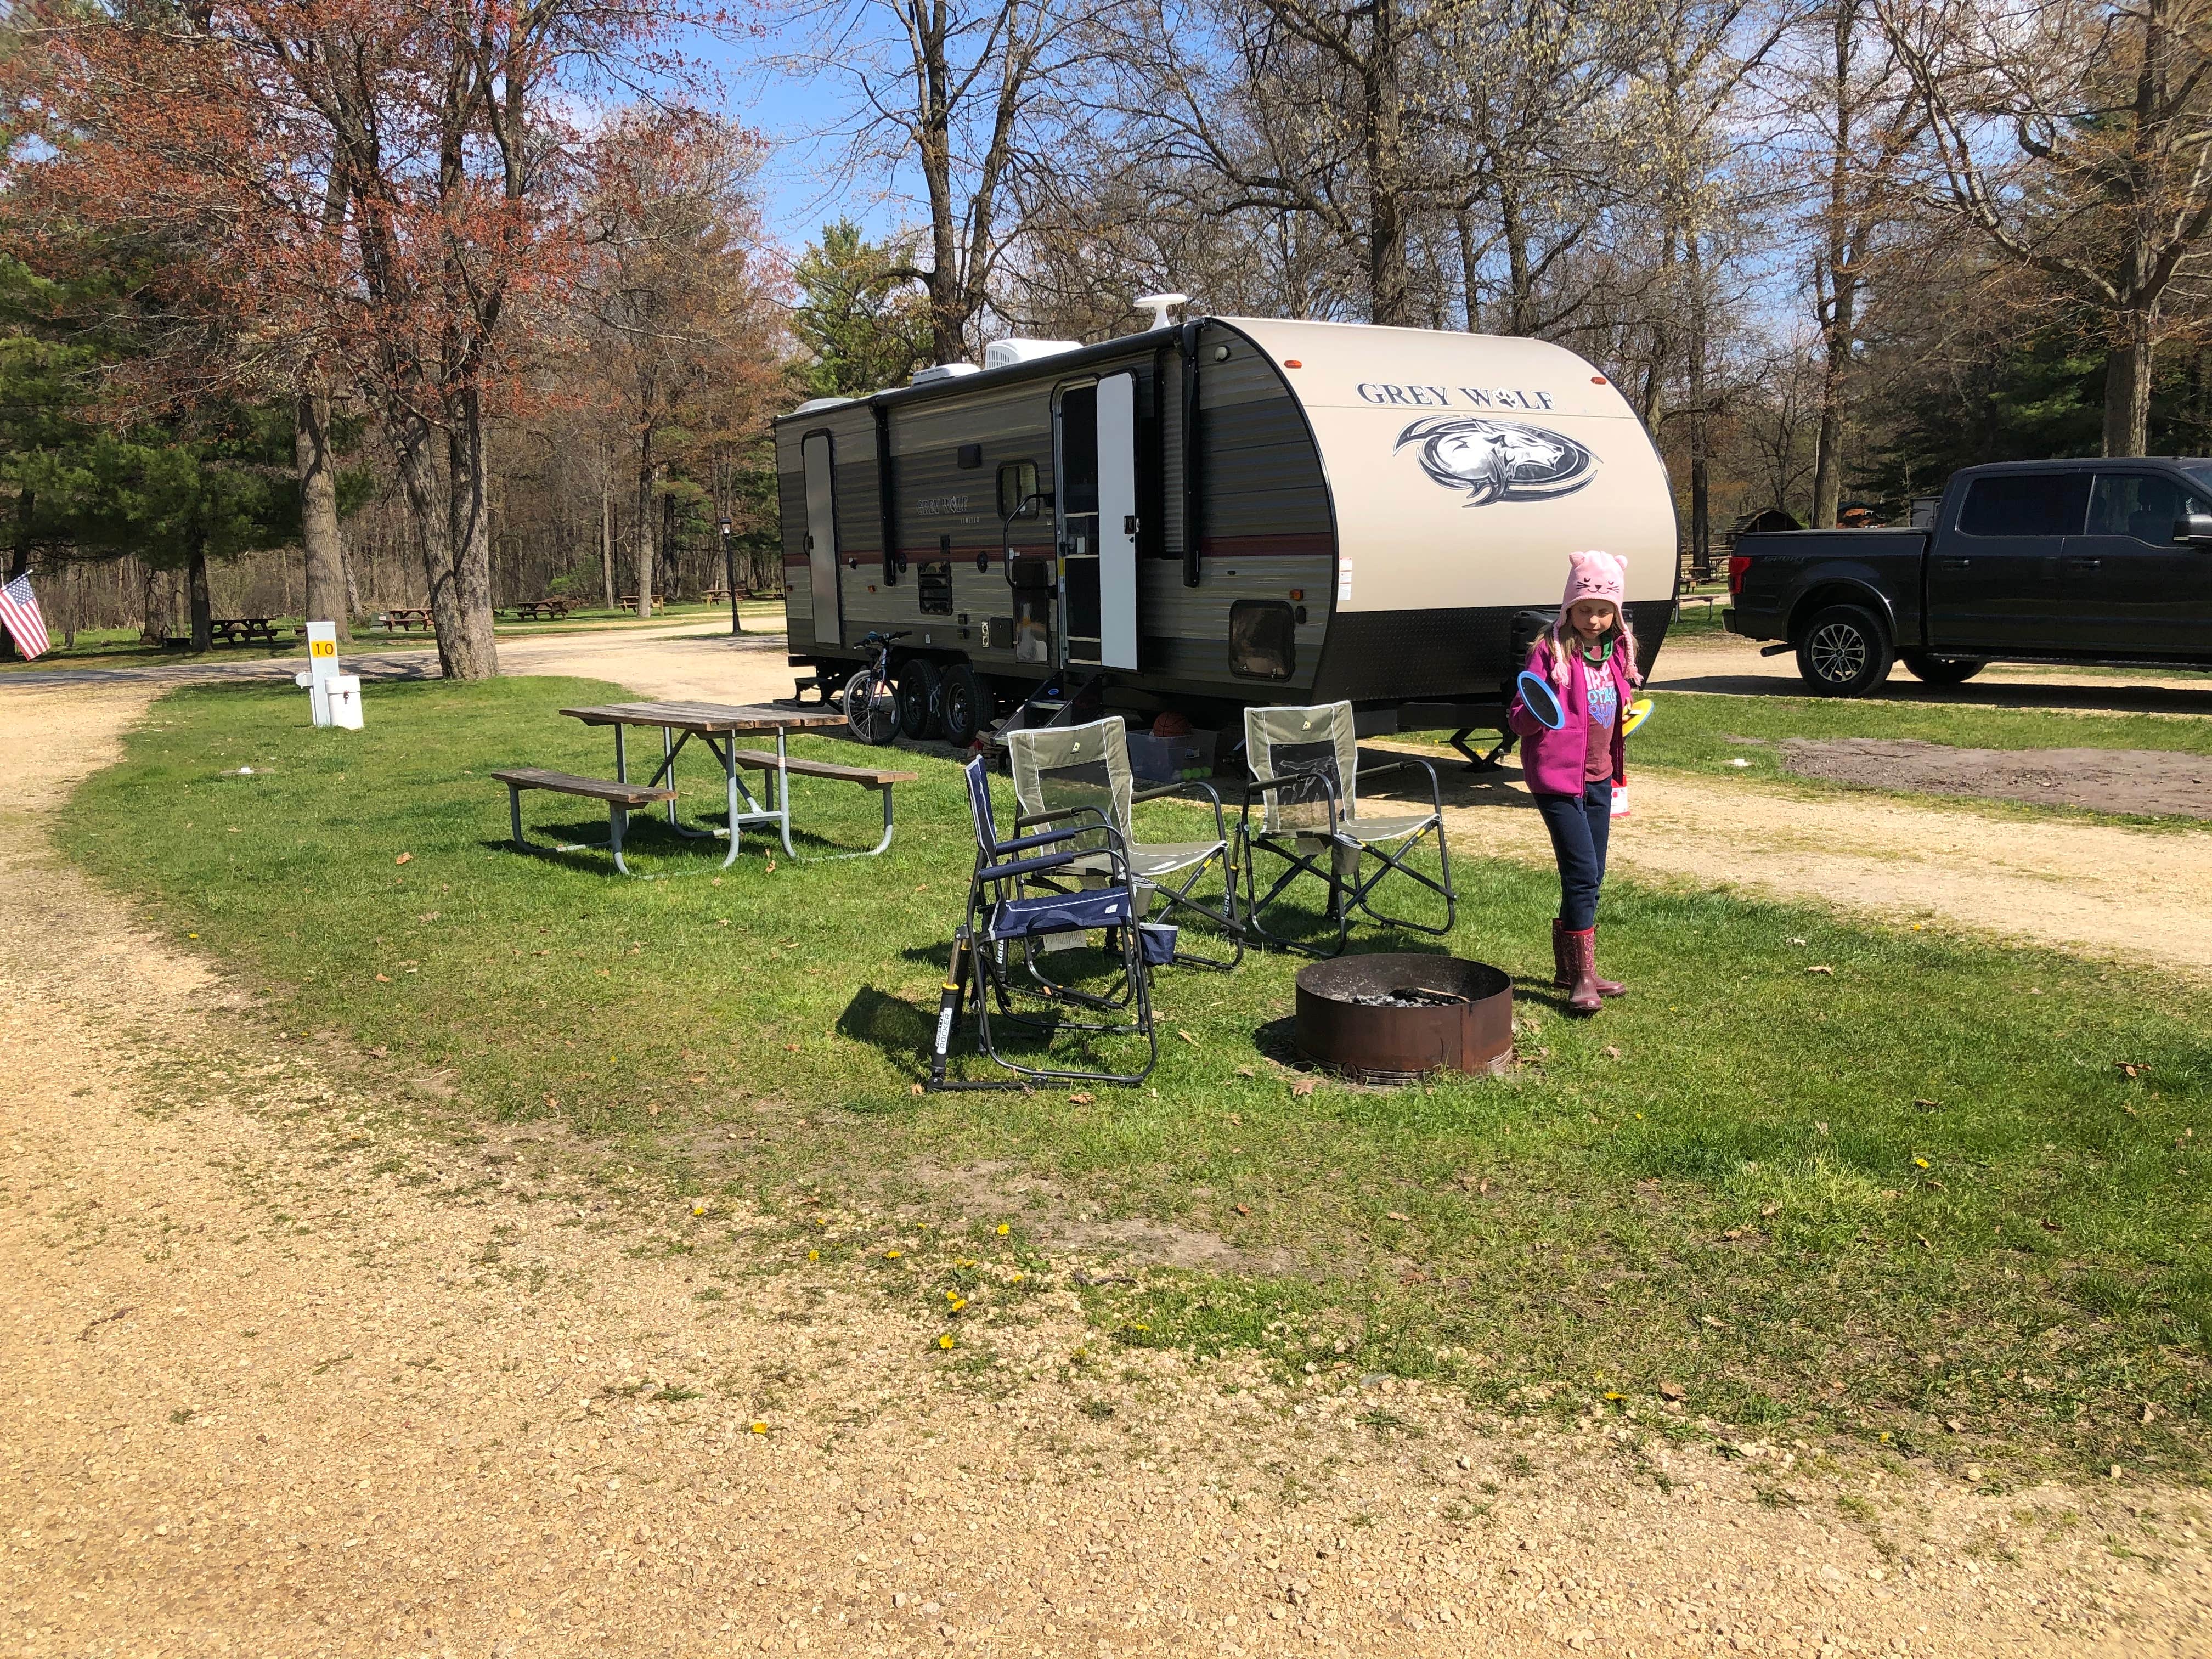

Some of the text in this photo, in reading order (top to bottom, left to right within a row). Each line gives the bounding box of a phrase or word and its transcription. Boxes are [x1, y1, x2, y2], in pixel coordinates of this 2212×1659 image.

[1356, 383, 1554, 410] GREY WOLF
[917, 498, 940, 515] GREY
[315, 643, 334, 655] 10
[939, 1012, 951, 1049] ROCKER
